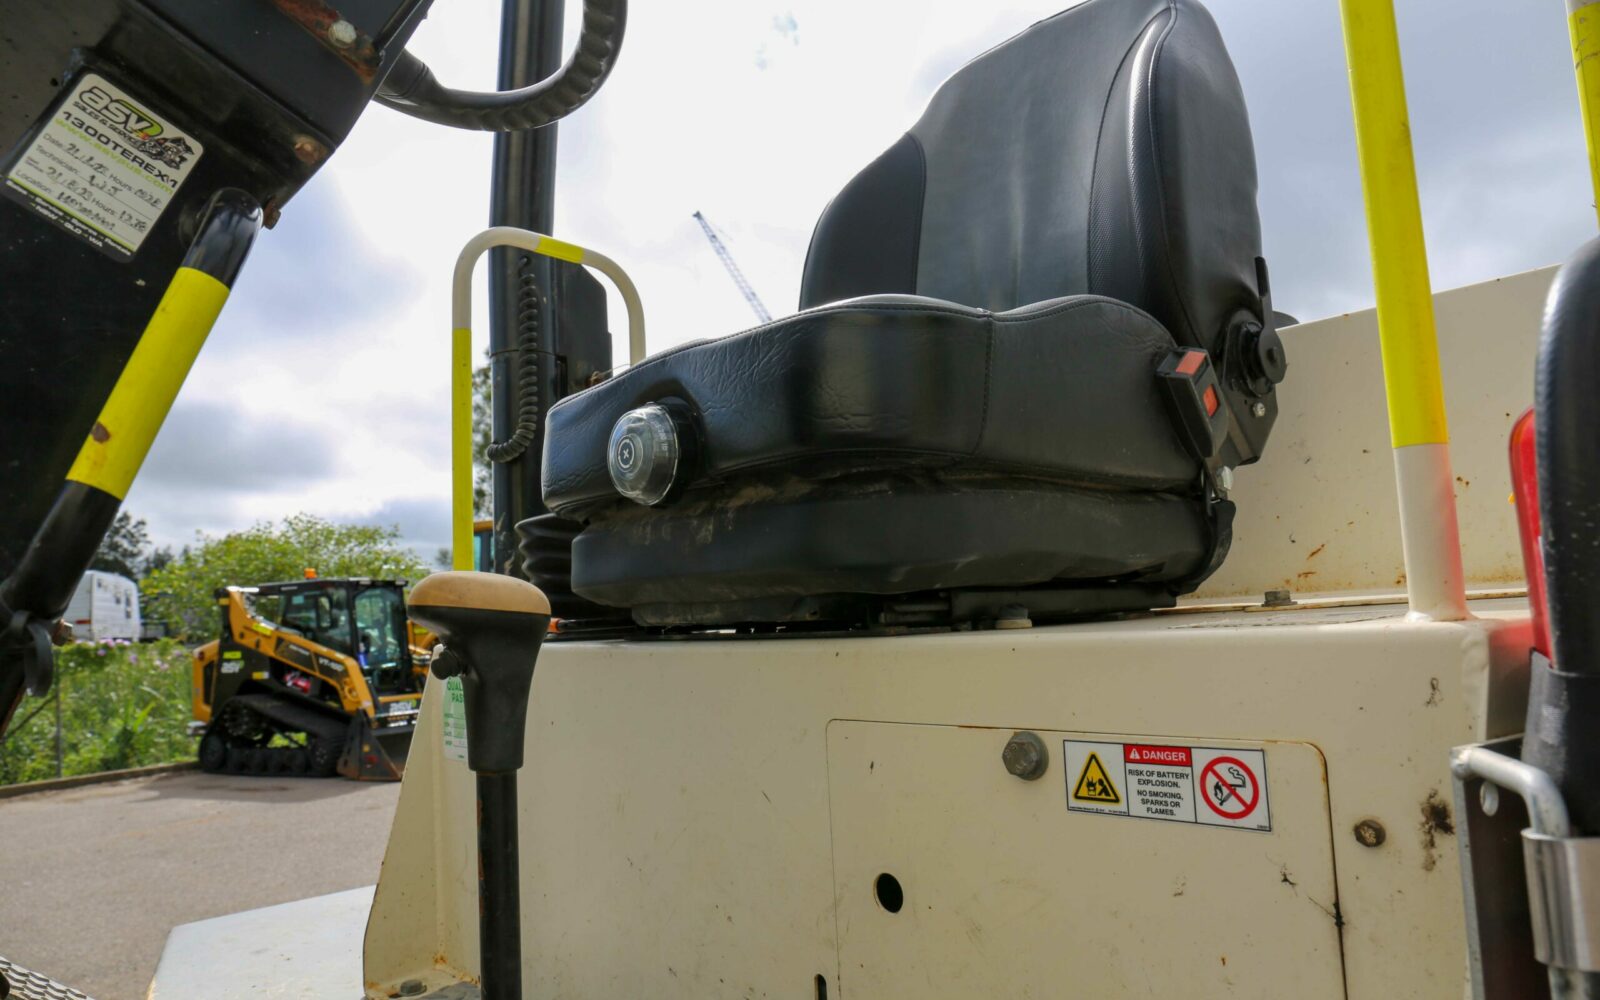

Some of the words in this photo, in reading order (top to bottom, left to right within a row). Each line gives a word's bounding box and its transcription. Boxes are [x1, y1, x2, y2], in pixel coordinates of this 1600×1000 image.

[447, 680, 464, 691] QUAL
[452, 692, 465, 703] PAS
[1142, 750, 1186, 762] DANGER
[1128, 769, 1145, 777] RISK
[1145, 770, 1156, 778] OF
[1156, 771, 1190, 780] BATTERY
[1137, 778, 1181, 789] EXPLOSION.
[1140, 798, 1169, 807] SPARKS
[1146, 807, 1177, 817] FLAMES.
